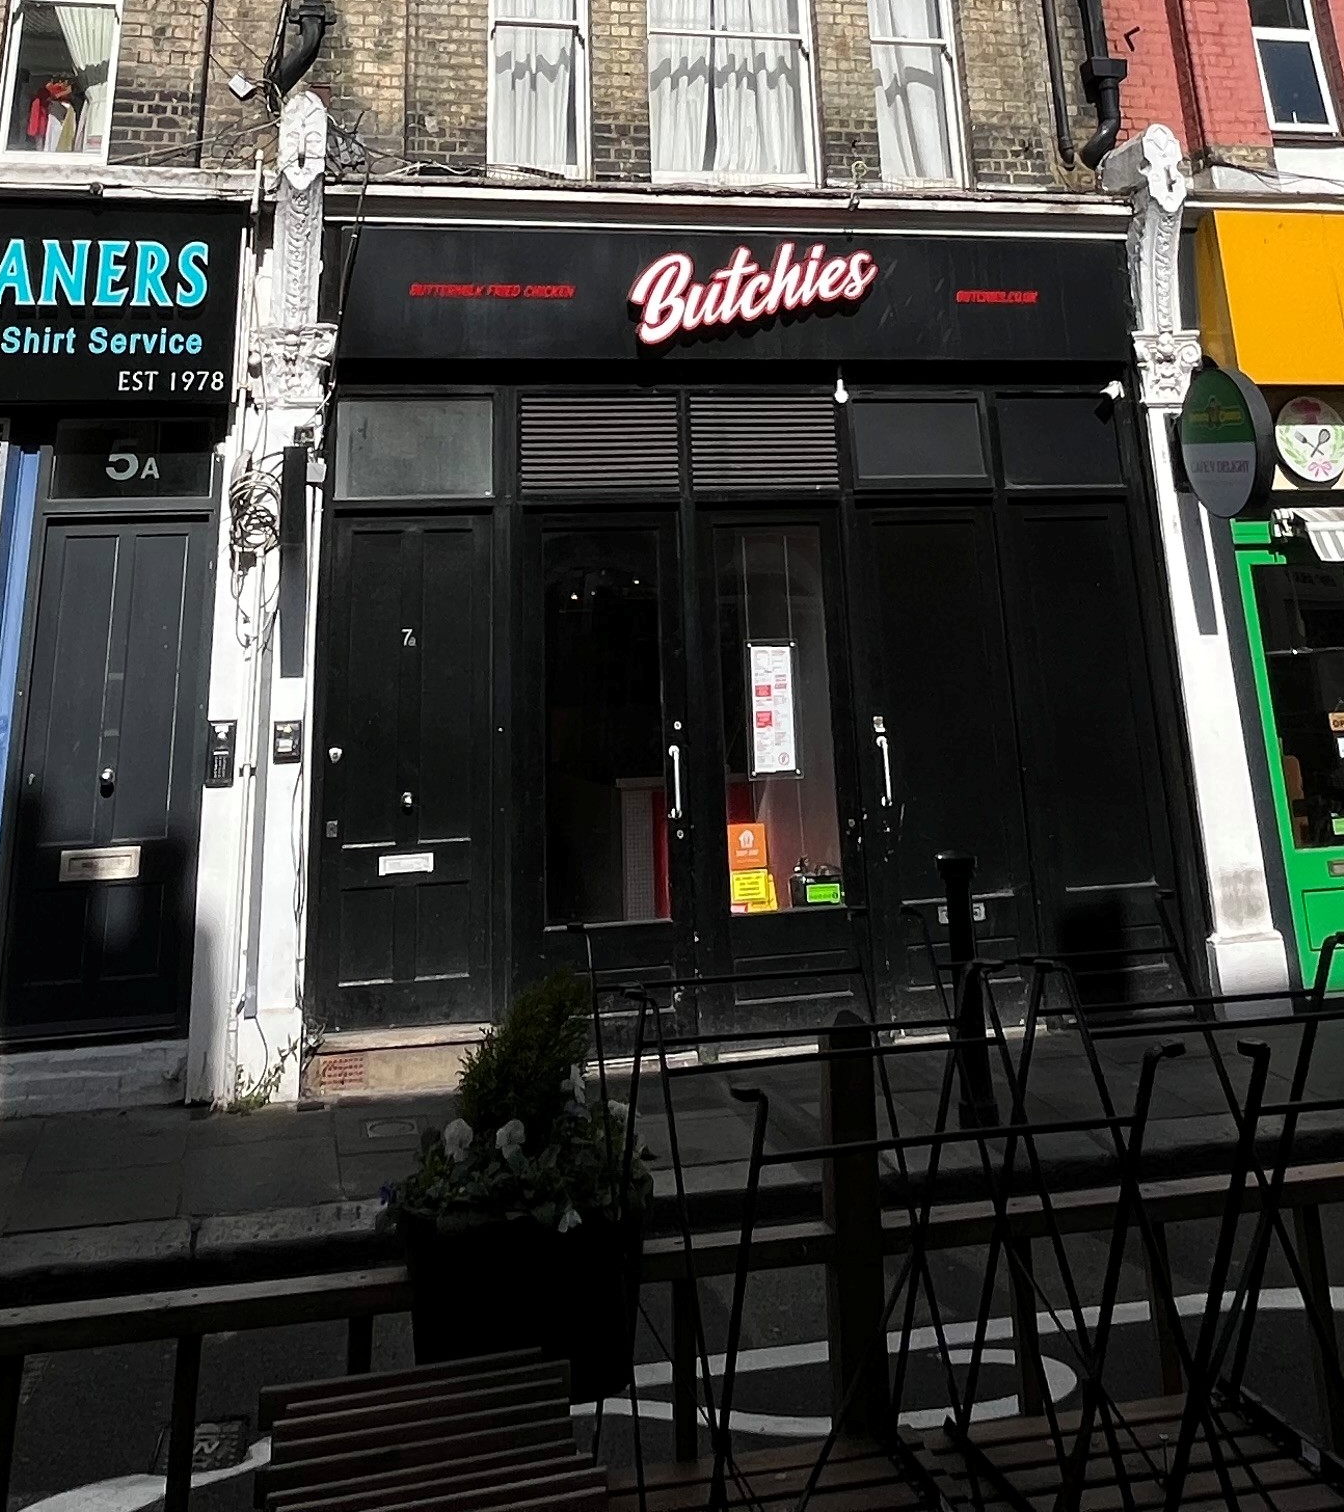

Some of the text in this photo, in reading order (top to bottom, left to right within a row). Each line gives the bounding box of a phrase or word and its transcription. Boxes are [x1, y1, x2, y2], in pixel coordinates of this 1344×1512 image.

[625, 242, 878, 346] Butchies
[0, 326, 77, 355] Shirt
[87, 327, 203, 355] Service
[117, 371, 225, 392] EST 1978
